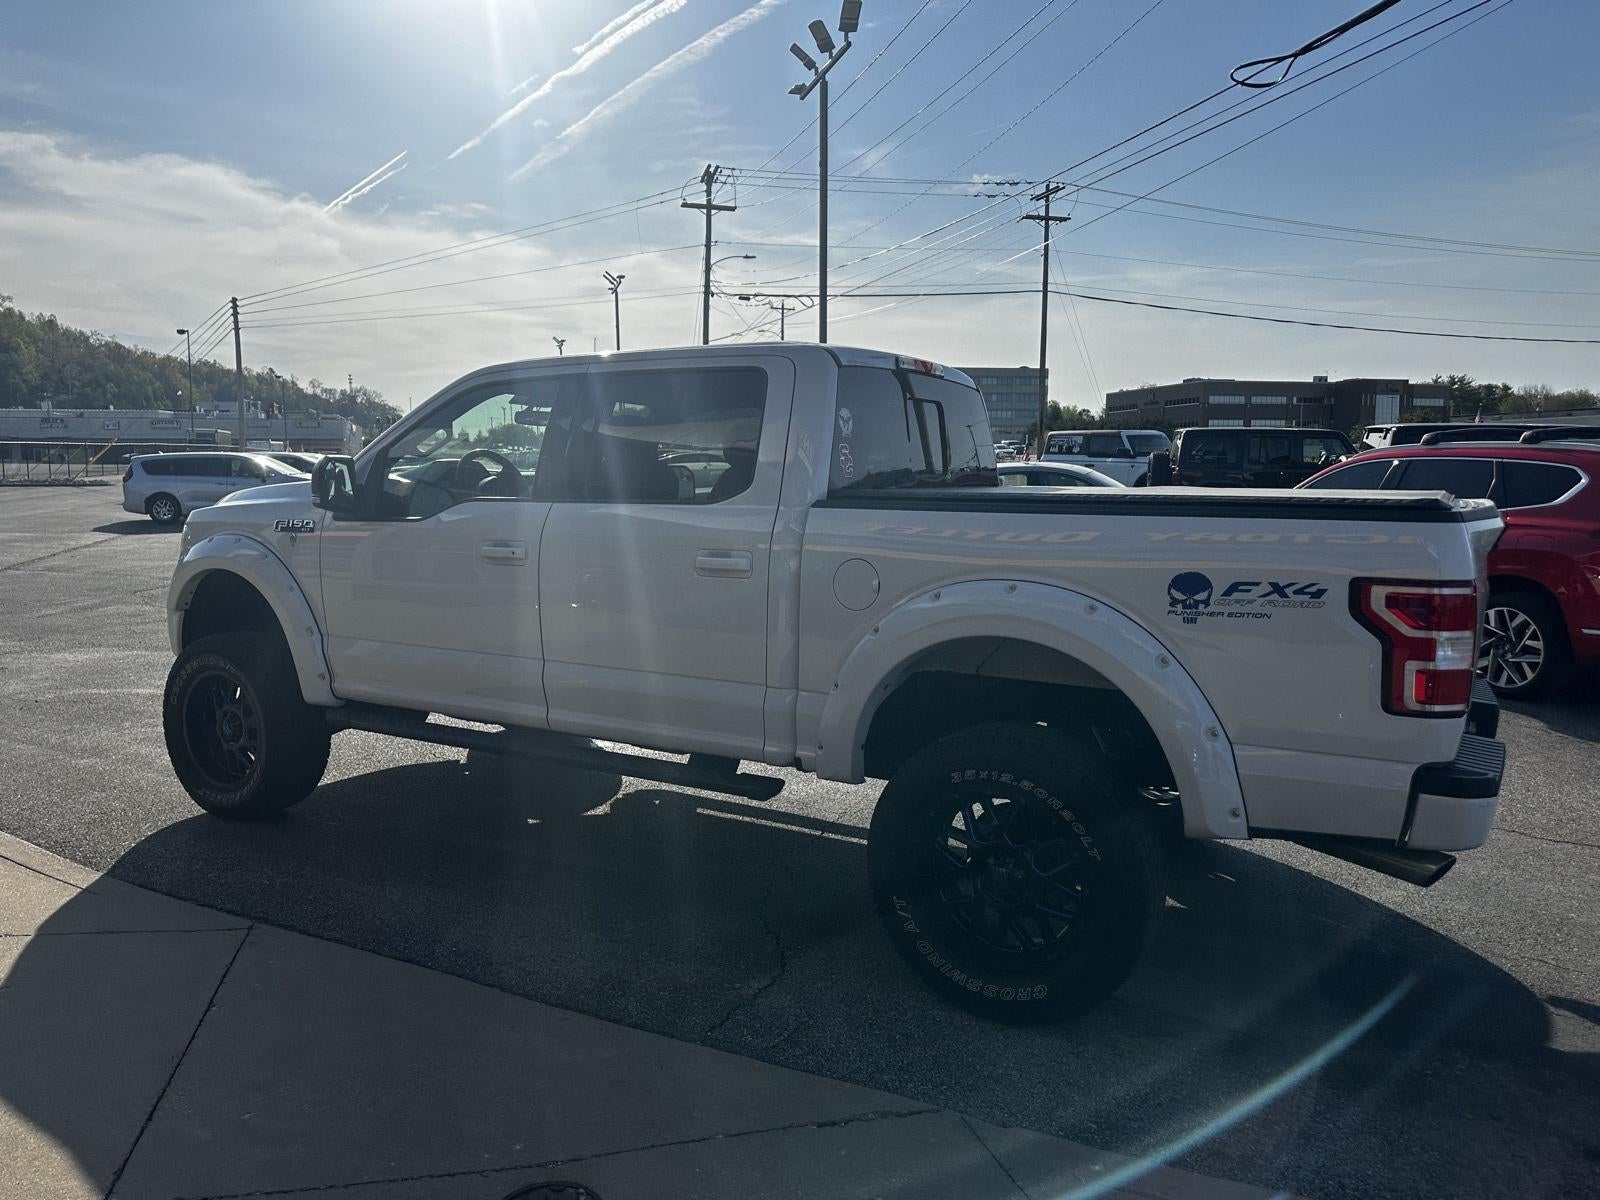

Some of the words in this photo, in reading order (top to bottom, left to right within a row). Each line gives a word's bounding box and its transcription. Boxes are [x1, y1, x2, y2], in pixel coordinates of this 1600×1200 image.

[1220, 581, 1329, 600] FX4
[1213, 599, 1257, 607] OFF
[1259, 600, 1326, 609] ROAD
[1167, 609, 1224, 618] PUNISHER
[915, 938, 1048, 1001] CROSSWIND
